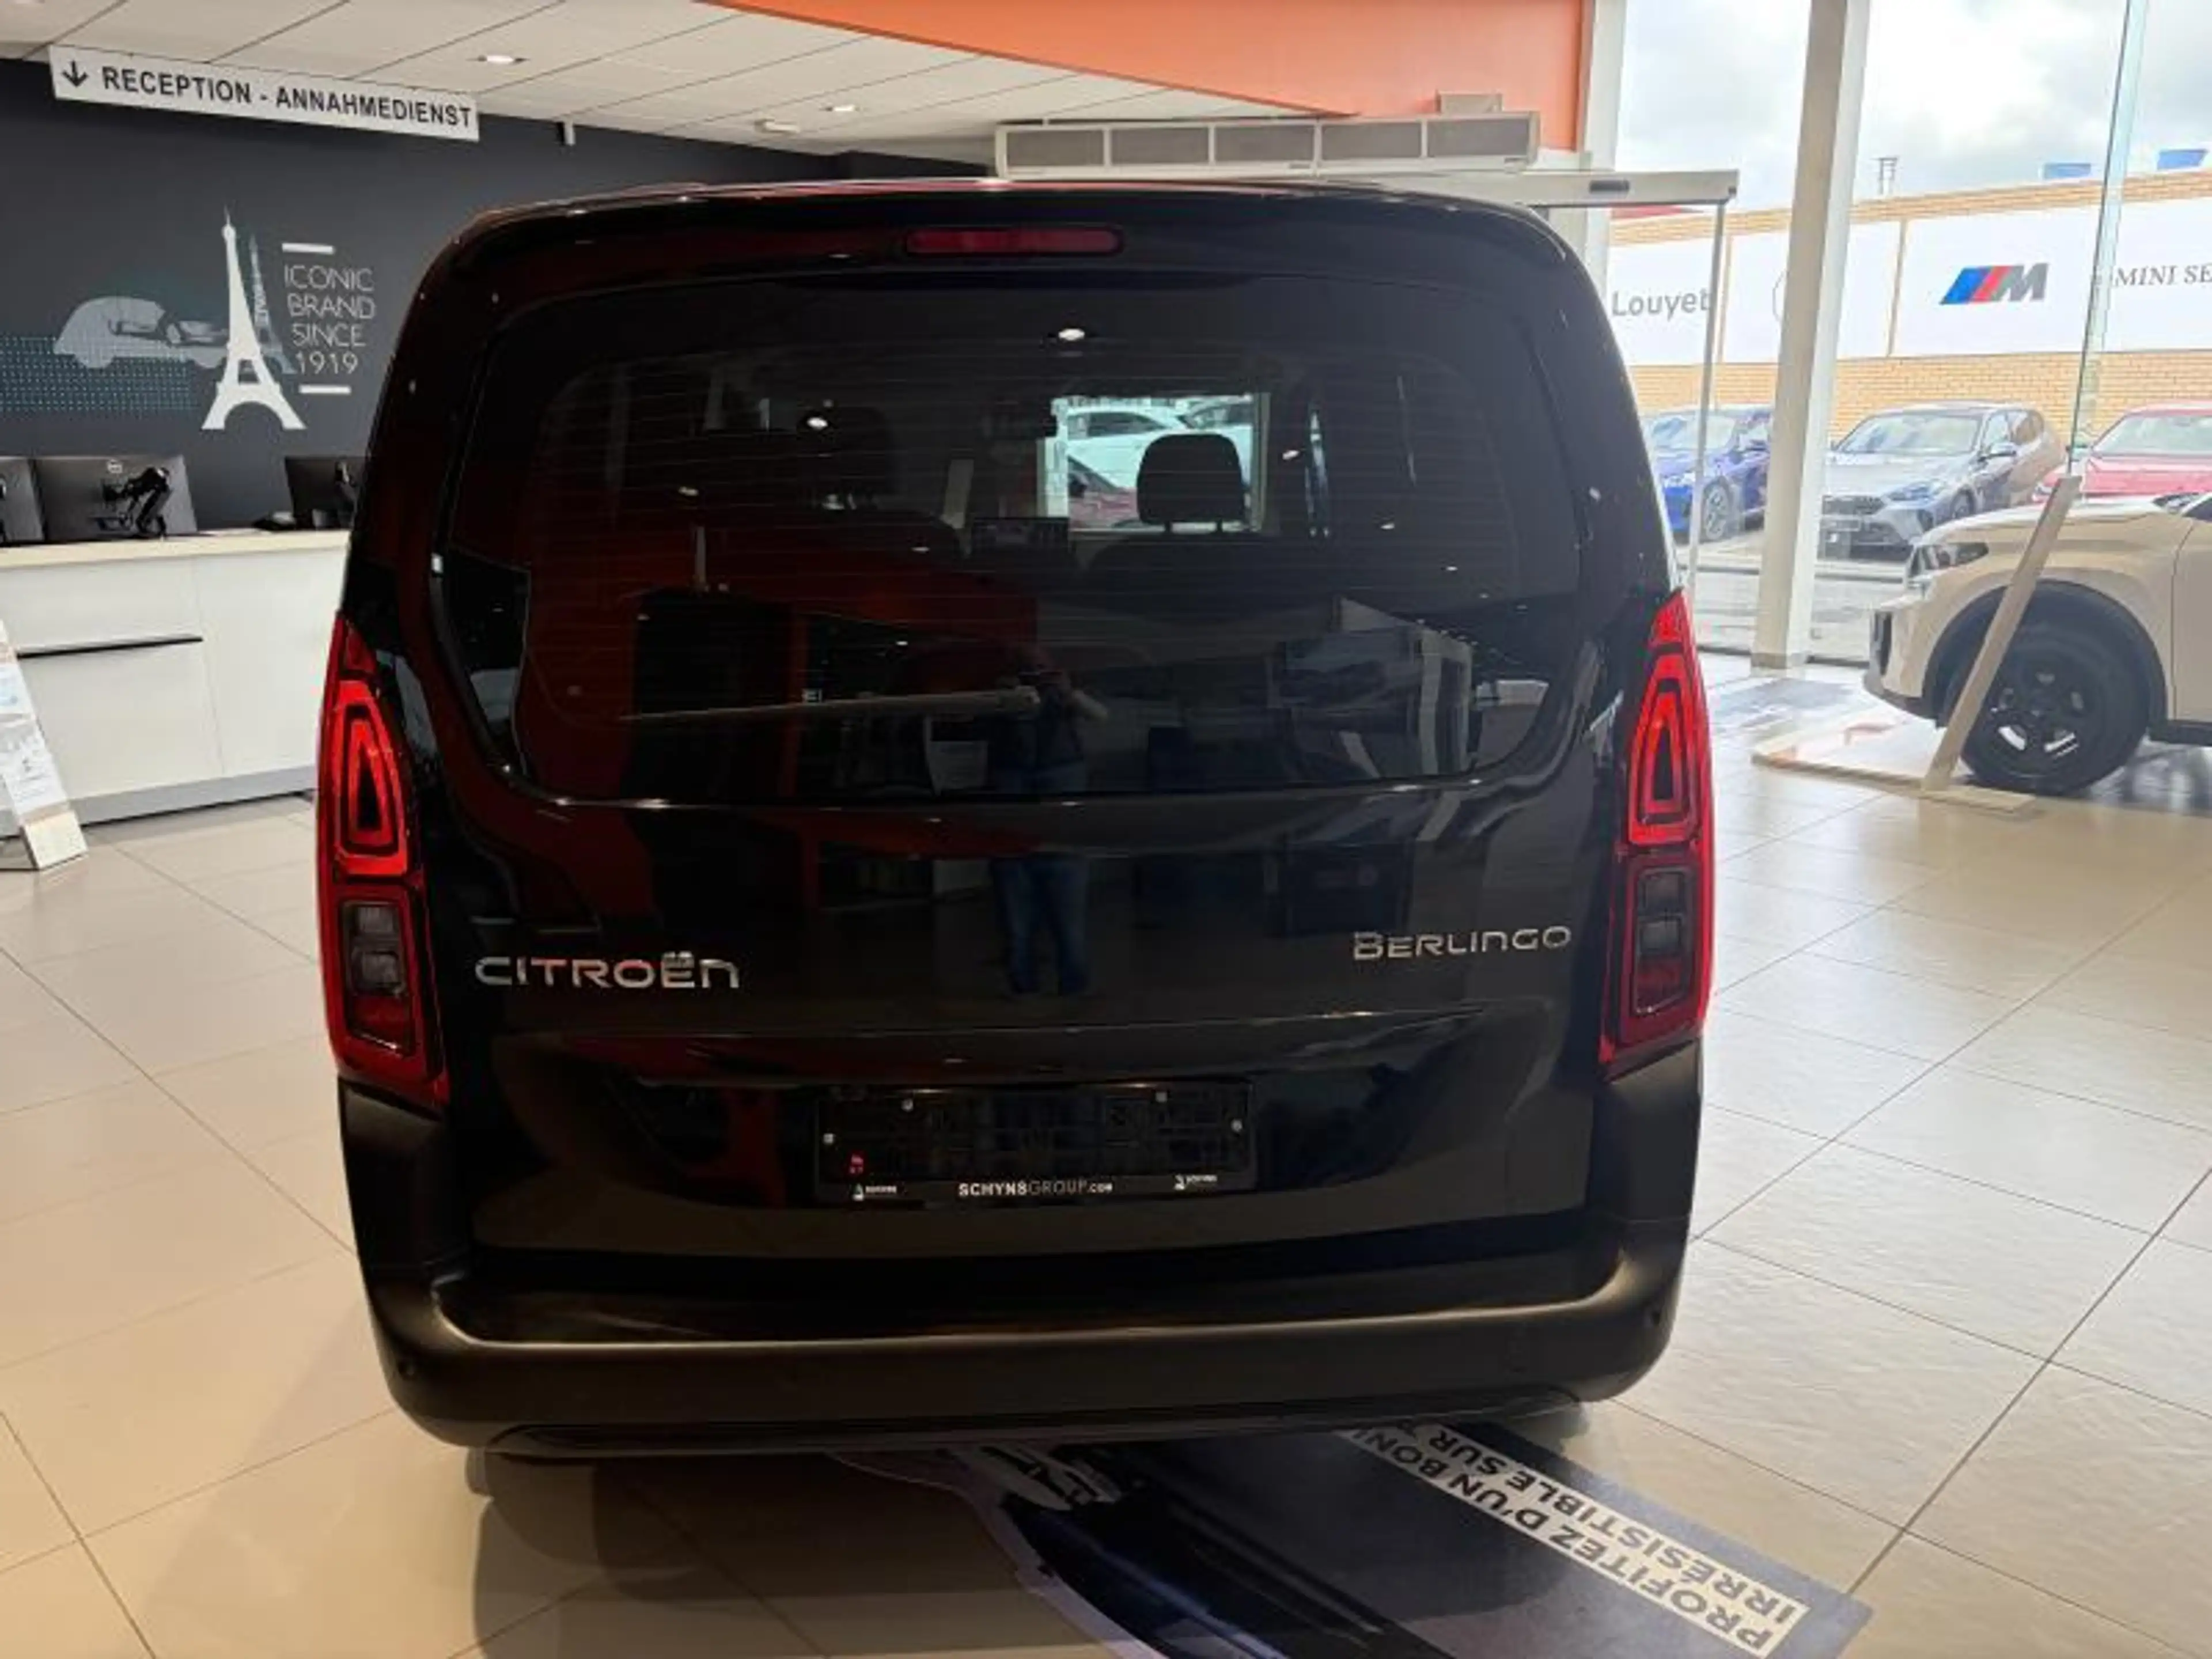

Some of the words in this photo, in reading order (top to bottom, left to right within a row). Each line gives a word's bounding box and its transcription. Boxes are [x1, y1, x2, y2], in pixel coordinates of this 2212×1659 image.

[102, 66, 252, 103] RECEPTION
[276, 86, 471, 127] ANNAHMEDIENST
[285, 264, 374, 291] ICONIC
[2115, 266, 2177, 287] MINI
[288, 293, 376, 319] BRAND
[1612, 287, 1712, 323] Louyet
[292, 323, 366, 347] SINCE
[295, 350, 358, 374] 1919
[1353, 926, 1572, 961] BERLINGO
[1429, 1429, 1508, 1475] SUR
[1449, 1473, 1550, 1531] D'UN
[1505, 1469, 1796, 1624] IRRÉSISTIBLE
[1551, 1524, 1774, 1651] PROFITEZ
